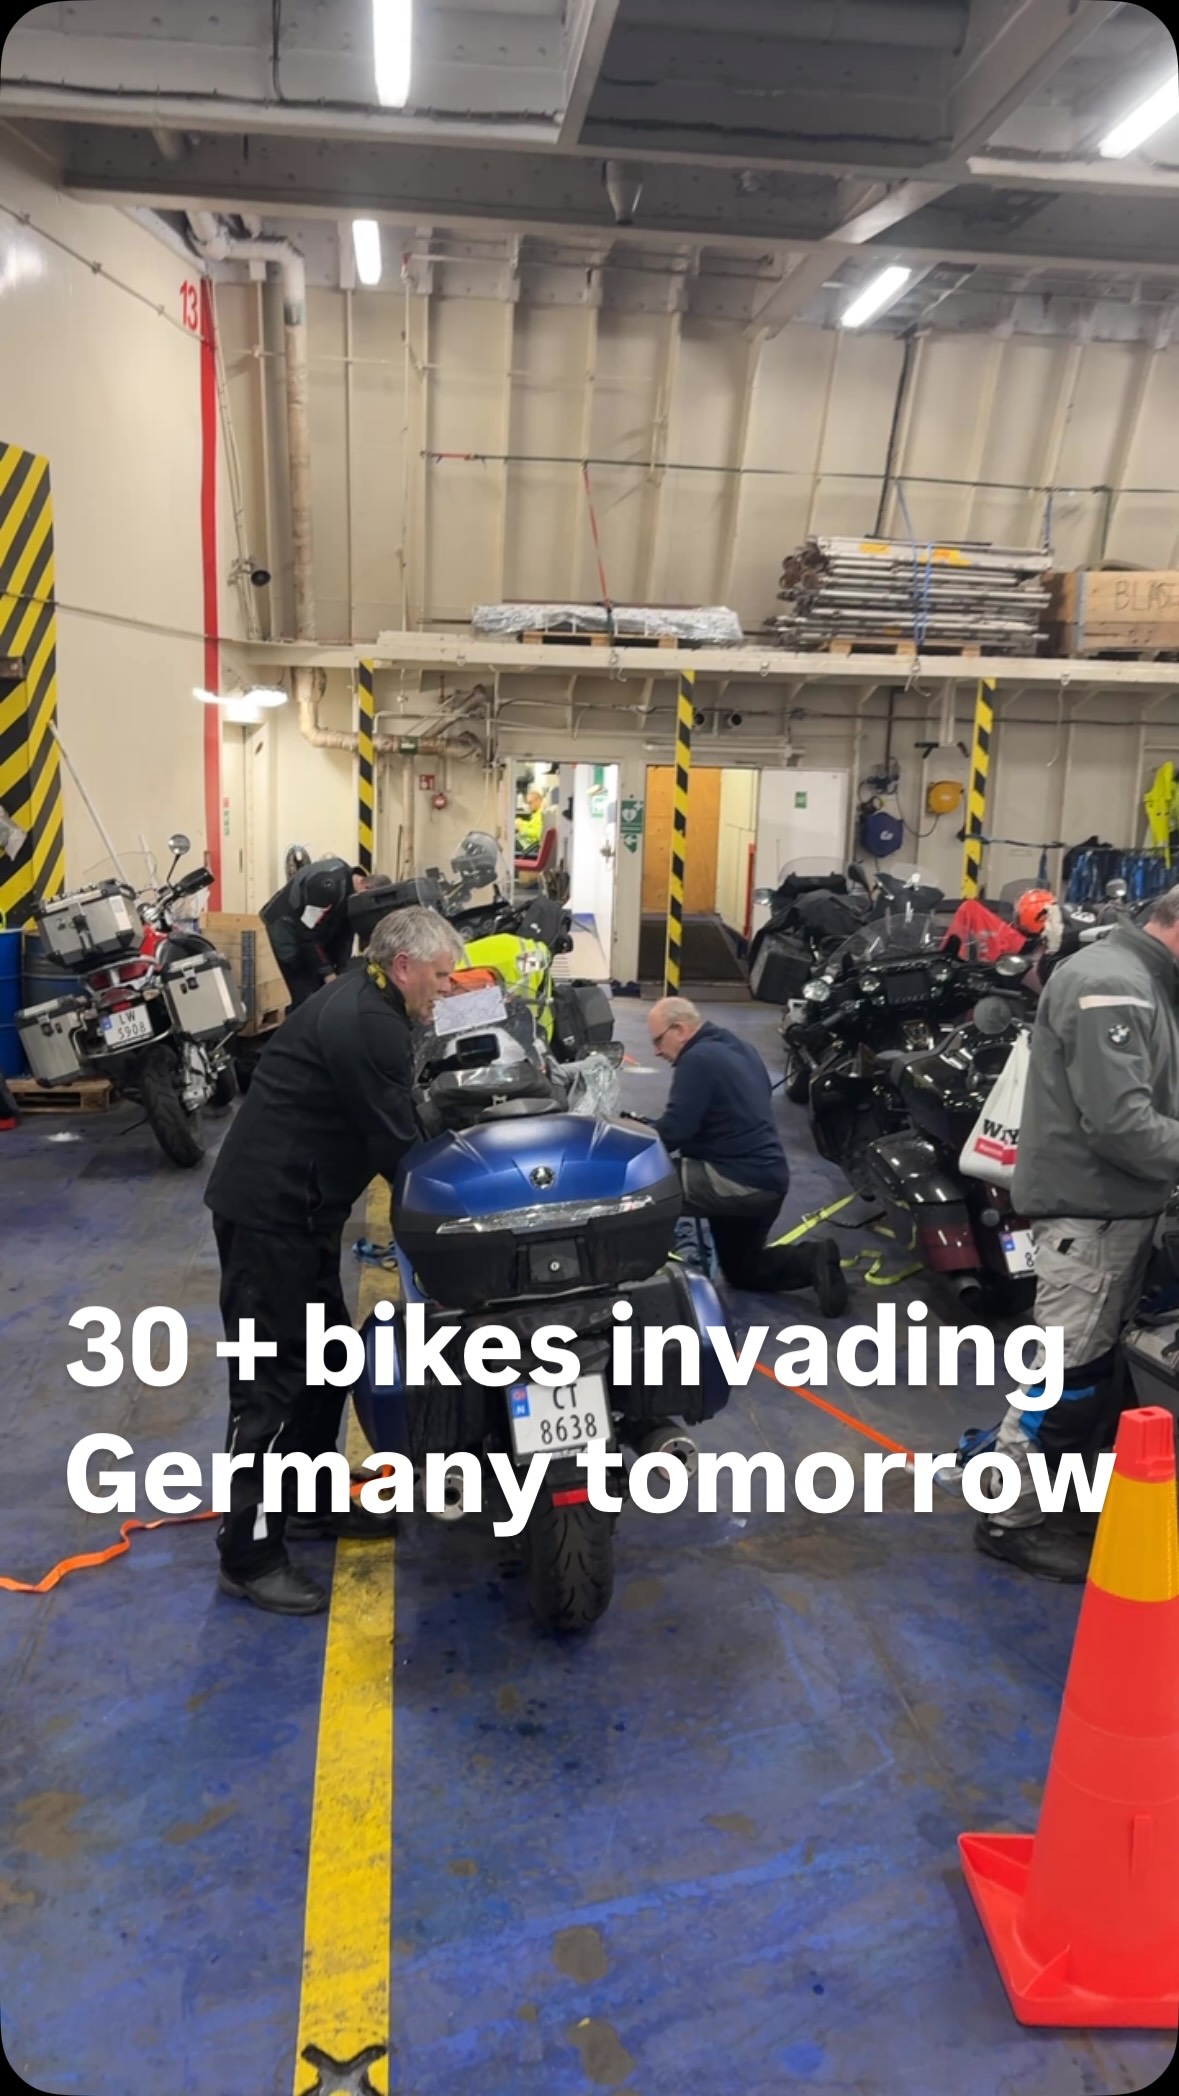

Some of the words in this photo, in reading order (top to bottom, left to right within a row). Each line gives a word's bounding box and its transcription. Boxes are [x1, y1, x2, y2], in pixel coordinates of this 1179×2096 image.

[180, 280, 198, 331] 13
[117, 1010, 136, 1025] LW
[117, 1021, 147, 1039] 5908
[552, 1383, 577, 1410] CT
[540, 1412, 598, 1445] 8638
